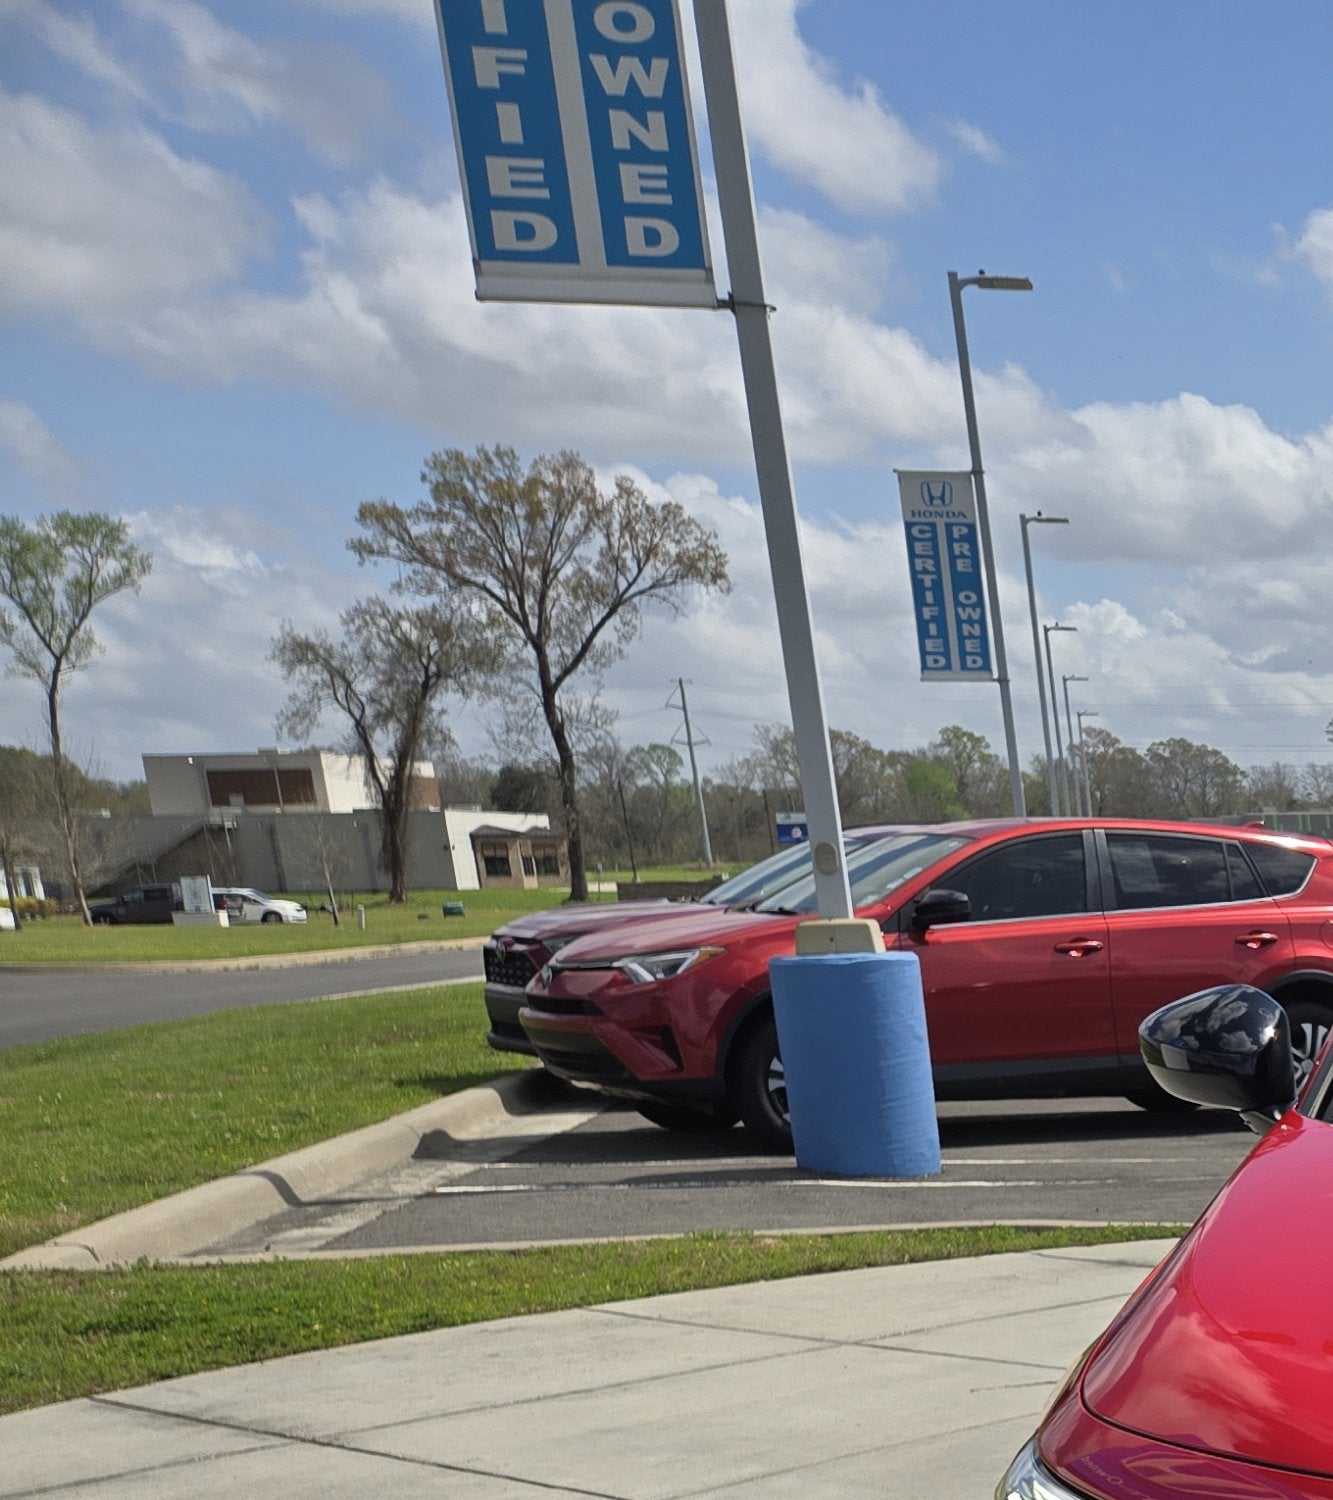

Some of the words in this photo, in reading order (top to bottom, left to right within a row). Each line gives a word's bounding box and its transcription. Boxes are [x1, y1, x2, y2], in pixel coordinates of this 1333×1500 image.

[589, 2, 680, 257] OWNED
[910, 509, 968, 519] HONDA
[952, 525, 973, 573] PRE
[911, 525, 946, 668] CERTIFIED
[957, 591, 984, 668] OWNED
